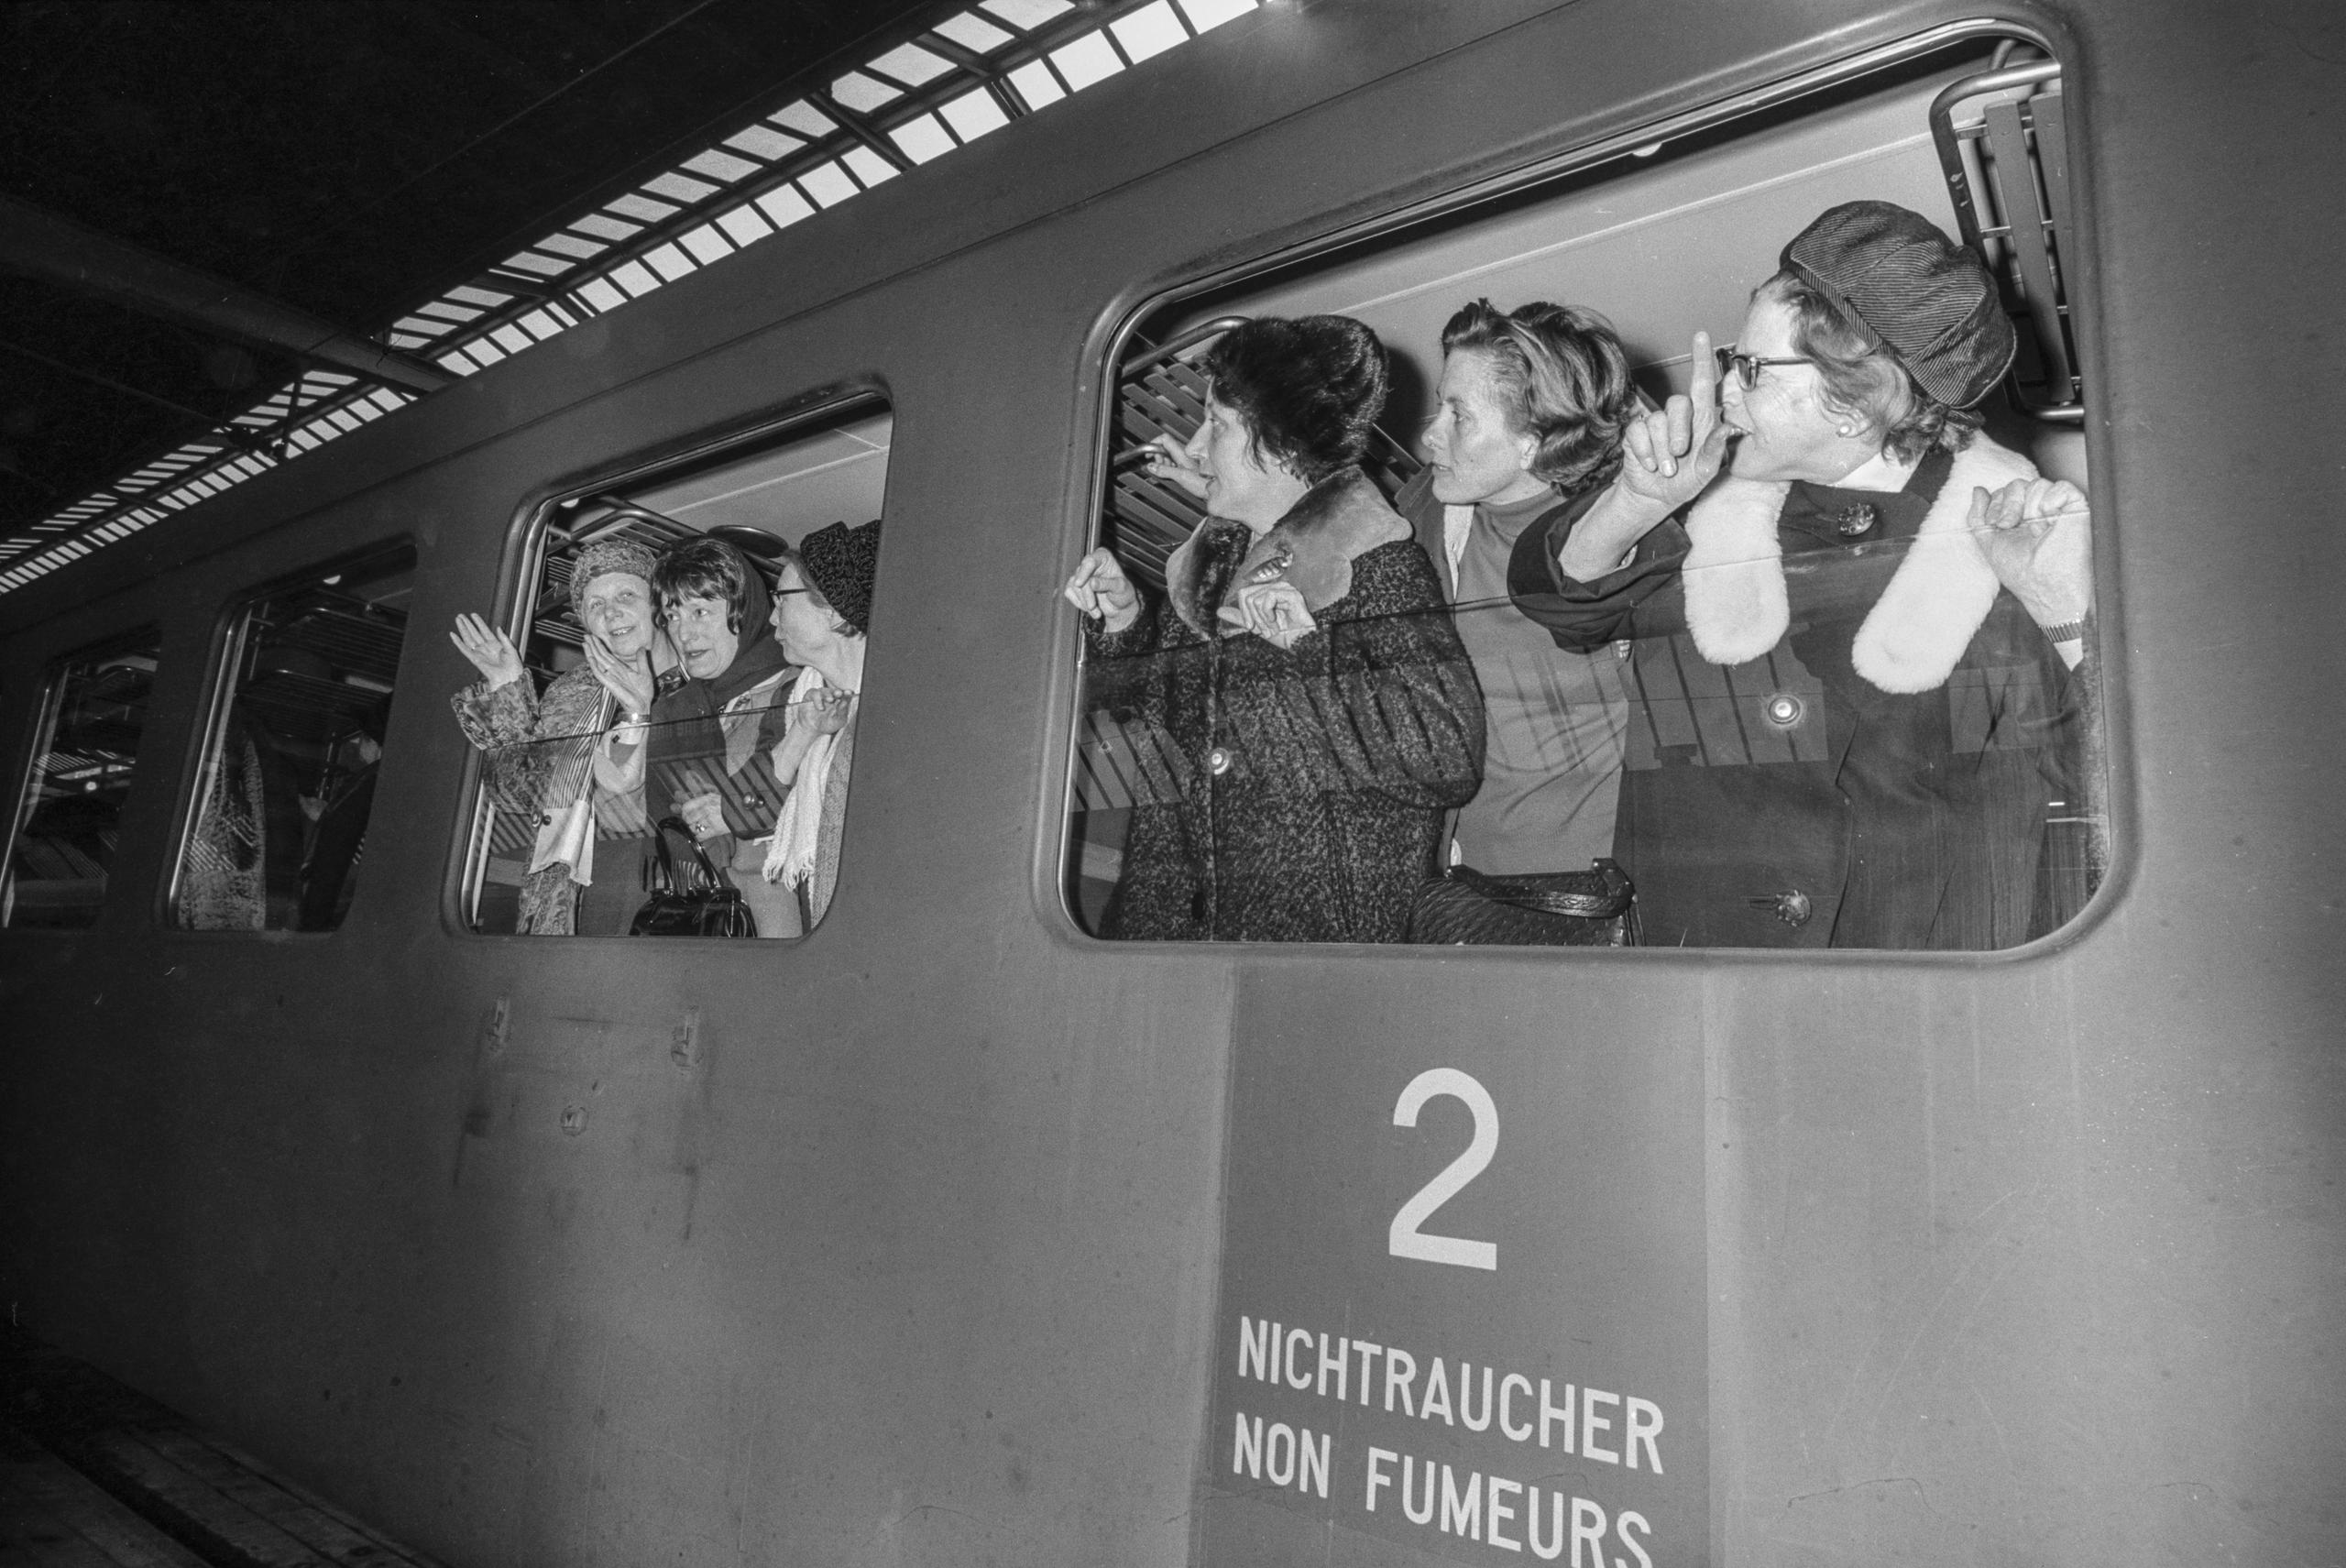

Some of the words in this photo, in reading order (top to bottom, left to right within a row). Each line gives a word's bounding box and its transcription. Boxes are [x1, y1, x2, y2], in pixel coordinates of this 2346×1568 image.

[1388, 1068, 1499, 1271] 2
[1238, 1316, 1664, 1475] NICHTRAUCHER
[1233, 1412, 1332, 1498] NON
[1365, 1446, 1652, 1568] FUMEURS
